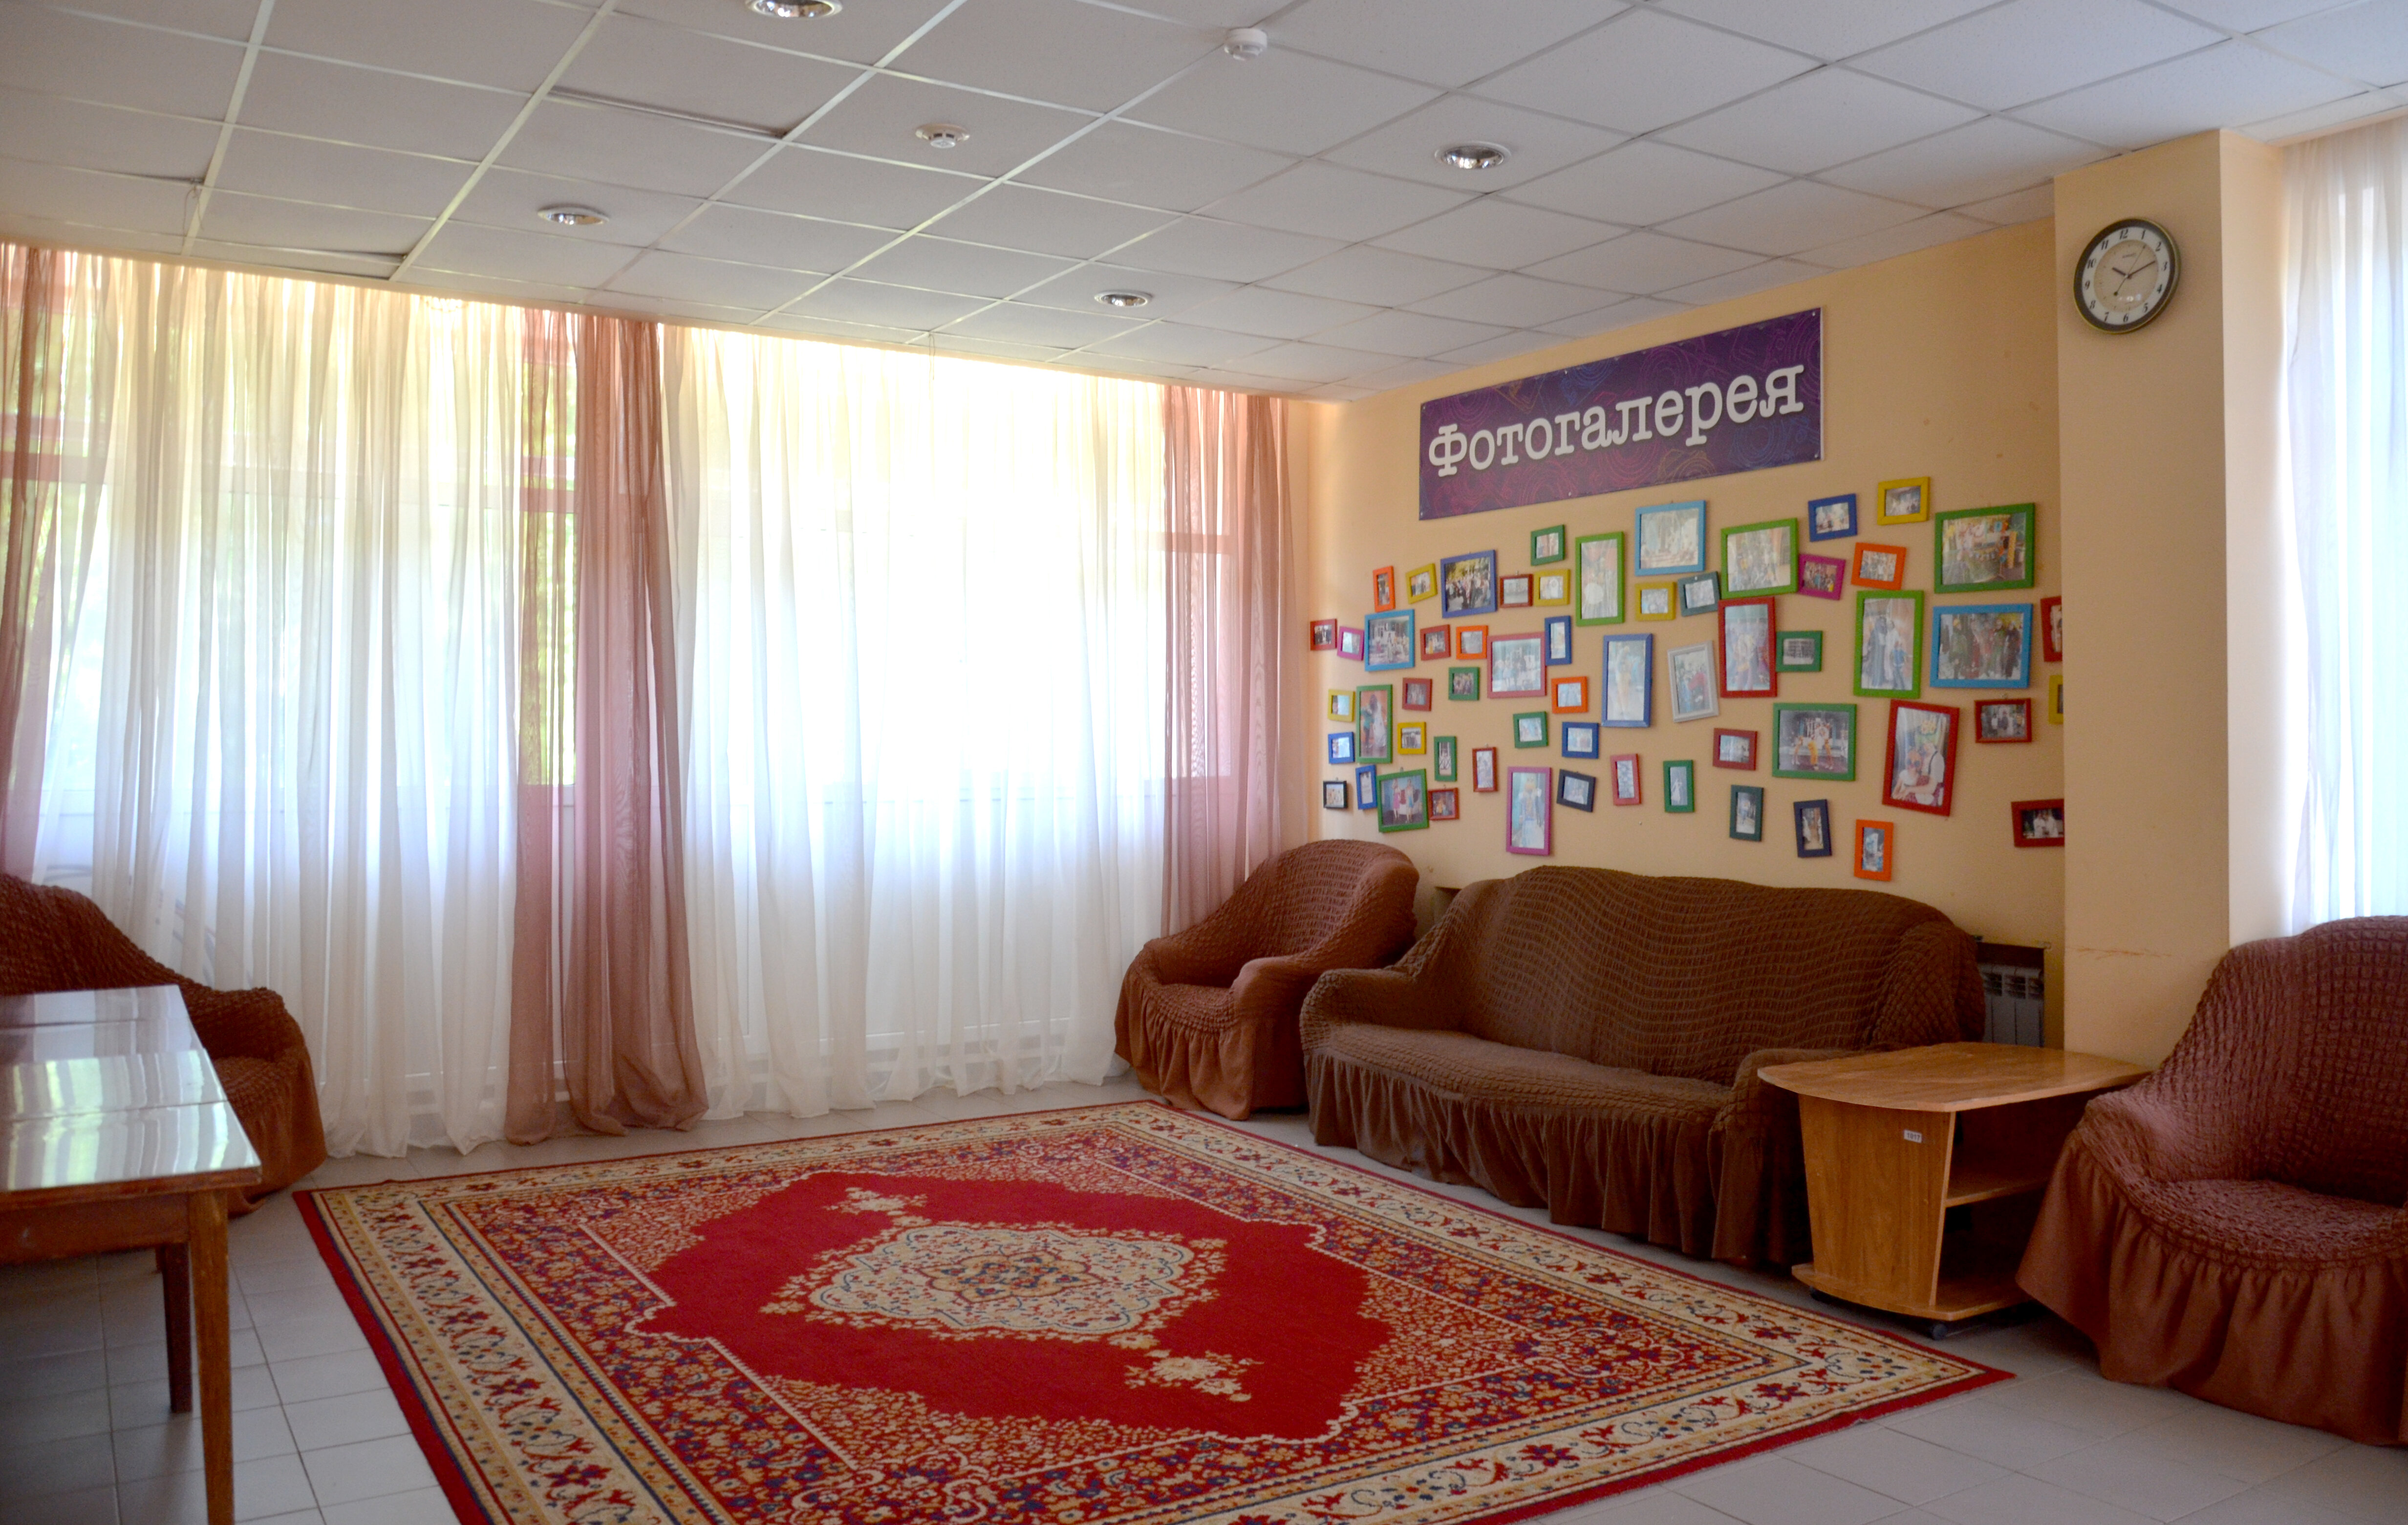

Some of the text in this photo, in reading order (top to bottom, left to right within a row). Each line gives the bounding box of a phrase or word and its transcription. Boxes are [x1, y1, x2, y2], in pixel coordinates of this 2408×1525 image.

[2119, 228, 2128, 240] 12
[2141, 229, 2146, 240] 1
[2101, 239, 2109, 250] 11
[2155, 241, 2162, 252] 2
[2087, 259, 2096, 269] 10
[2161, 261, 2168, 271] 3
[2084, 280, 2091, 290] 9
[2156, 284, 2163, 294] 4
[2089, 300, 2096, 309] 8
[2142, 302, 2148, 313] 5
[2104, 311, 2109, 322] 7
[2123, 313, 2129, 323] 6
[1428, 364, 1805, 478] Фотогалерея
